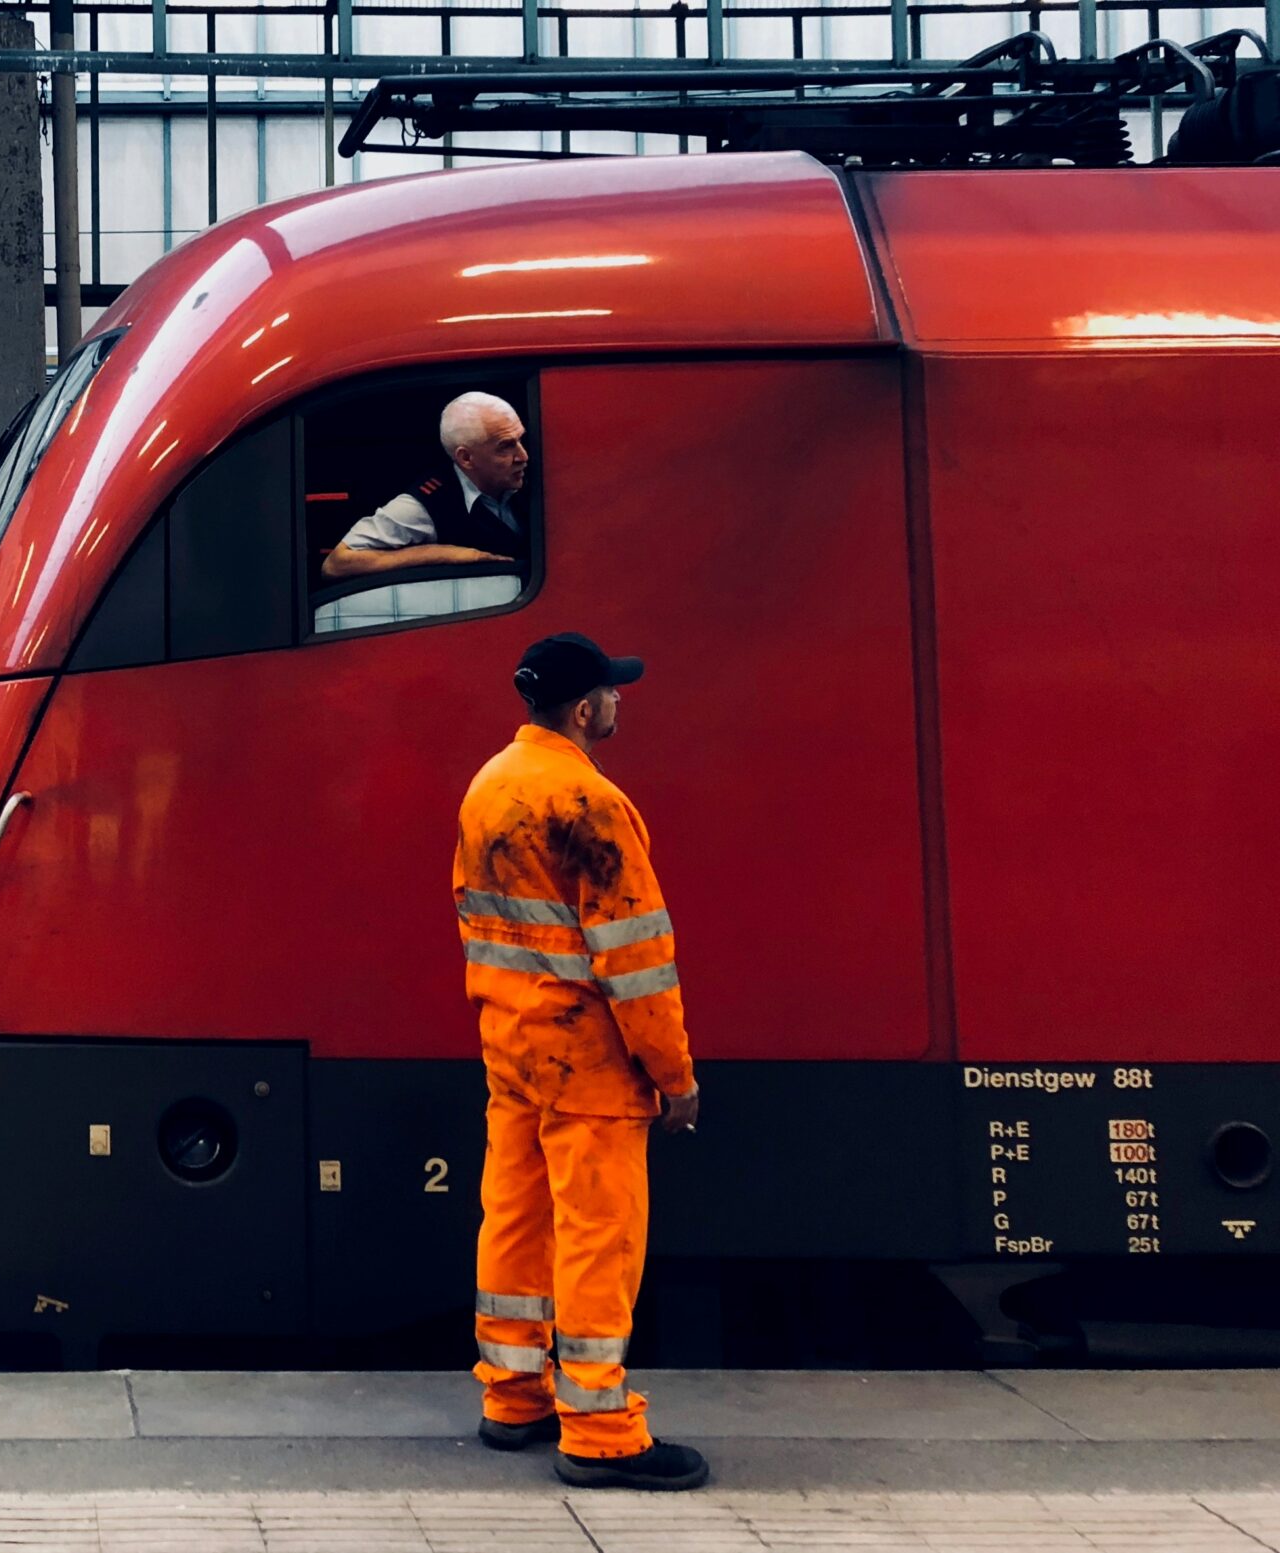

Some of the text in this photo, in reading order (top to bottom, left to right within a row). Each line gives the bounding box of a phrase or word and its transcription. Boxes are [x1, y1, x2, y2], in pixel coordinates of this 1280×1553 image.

[963, 1067, 1153, 1093] Dienstgew 88t
[989, 1120, 1155, 1139] R+E 180t
[990, 1143, 1157, 1162] P+E 100t
[424, 1157, 449, 1192] 2
[991, 1167, 1157, 1184] R 140t
[993, 1190, 1159, 1208] P 67t
[993, 1212, 1160, 1230] G 67t
[995, 1236, 1160, 1256] FspBr 25t
